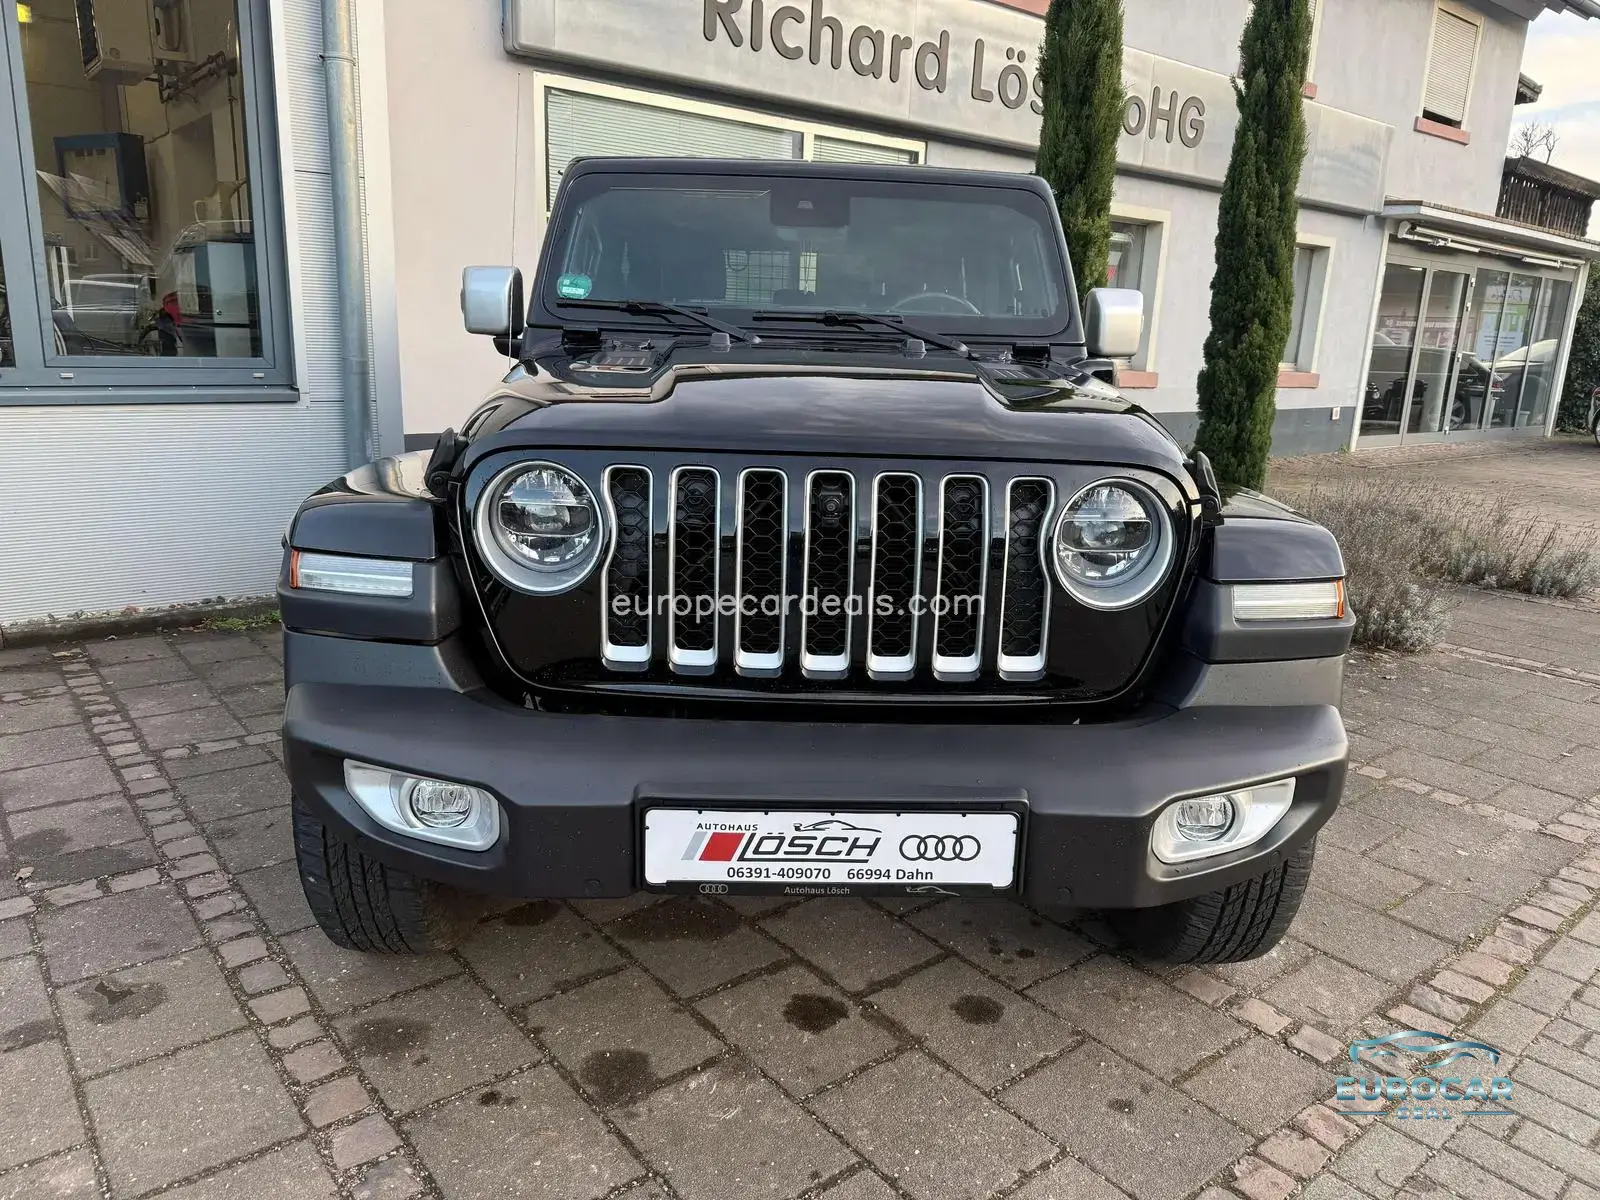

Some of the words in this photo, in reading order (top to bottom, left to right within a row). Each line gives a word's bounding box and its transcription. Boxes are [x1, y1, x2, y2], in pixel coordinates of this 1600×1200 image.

[703, 0, 950, 93] Richard
[1123, 85, 1205, 148] oHG
[696, 822, 758, 831] AUTOHAUS
[737, 832, 881, 863] LÖSCH
[727, 867, 831, 879] 06391-409070
[847, 869, 891, 880] 66994
[896, 869, 934, 880] Dahn
[784, 886, 825, 895] Autohaus
[826, 886, 850, 895] Lösch
